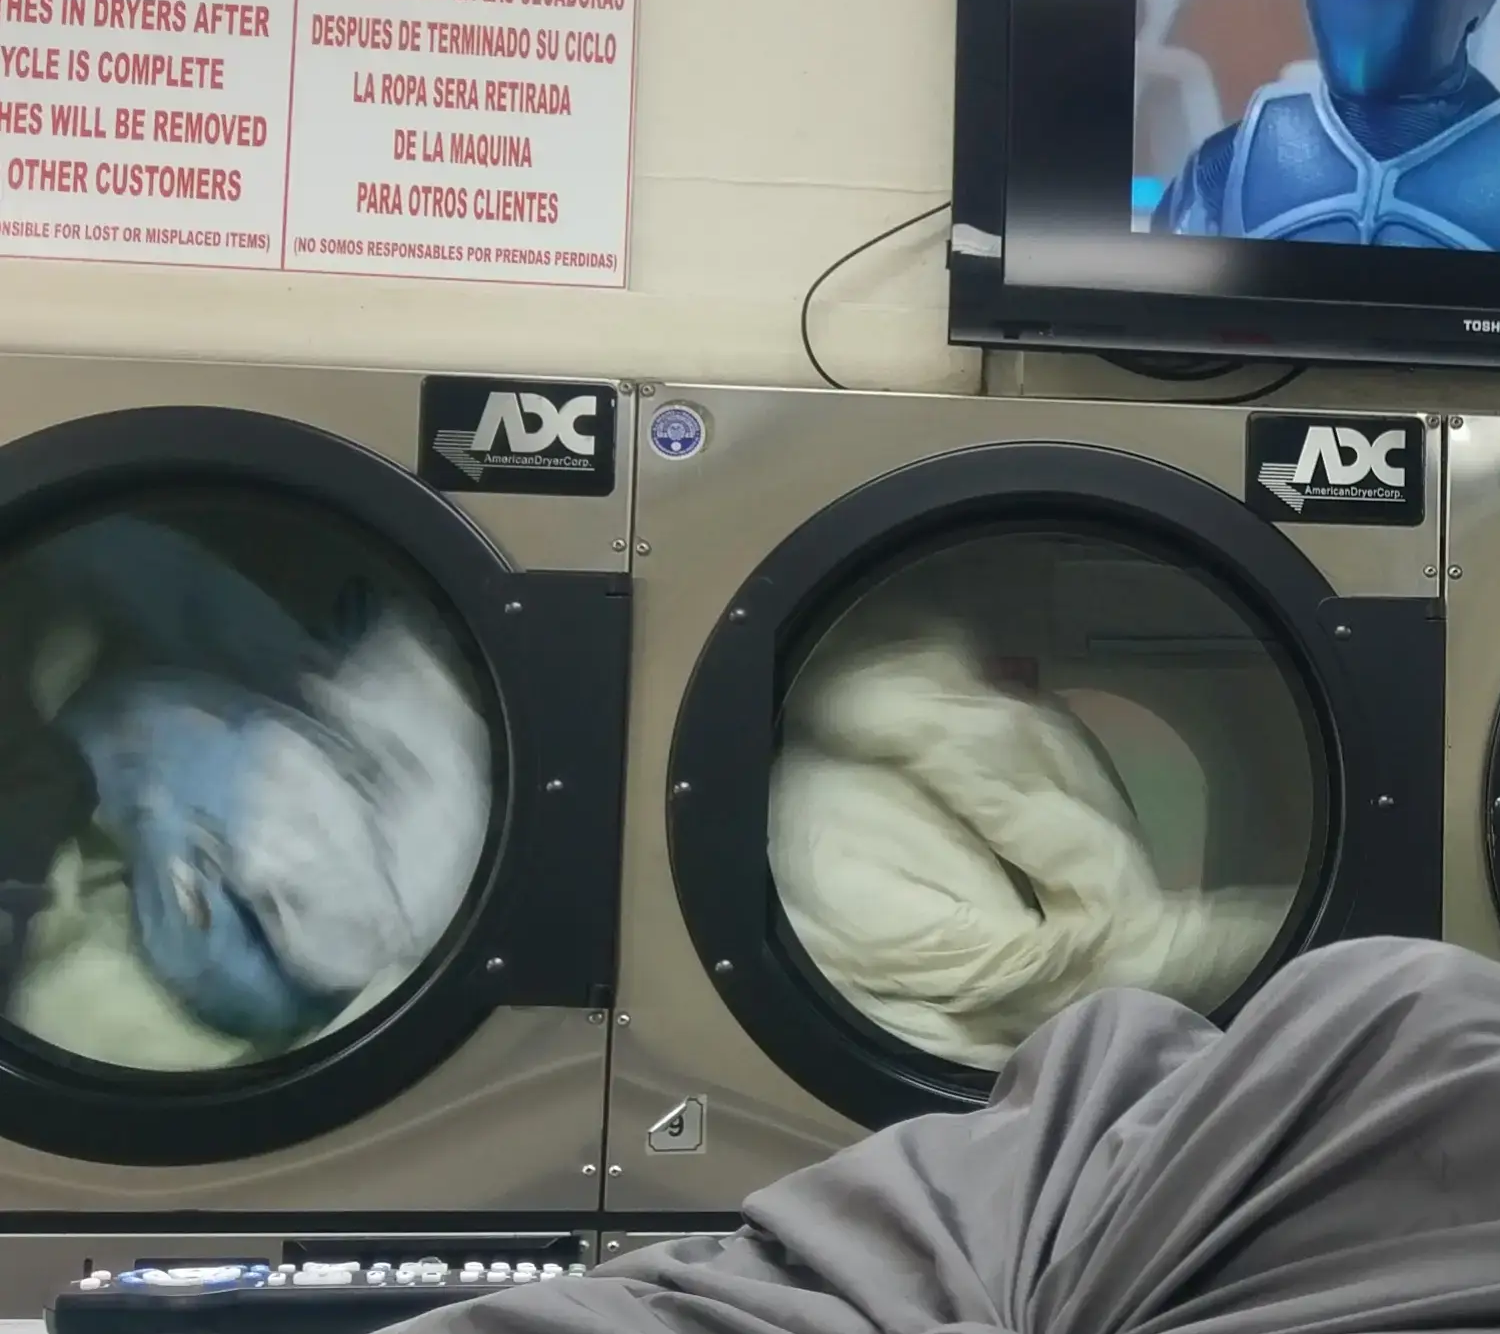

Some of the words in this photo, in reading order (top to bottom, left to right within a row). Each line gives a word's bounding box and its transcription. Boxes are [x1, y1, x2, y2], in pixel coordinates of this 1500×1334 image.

[193, 2, 270, 38] AFTER
[311, 14, 392, 49] DESPUES
[398, 19, 421, 51] DE
[427, 22, 531, 58] TERMINADO
[536, 28, 560, 60] SU
[565, 30, 617, 64] CICLO
[1, 46, 60, 80] YCLE
[67, 50, 91, 82] IS
[98, 52, 225, 90] COMPLETE
[353, 71, 375, 103] LA
[381, 73, 427, 107] ROPA
[433, 77, 479, 110] SERA
[485, 80, 572, 115] RETIRADA
[51, 104, 107, 139] WILL
[114, 108, 146, 141] BE
[153, 110, 267, 147] REMOVED
[393, 129, 417, 161] DE
[422, 132, 444, 163] LA
[450, 133, 533, 168] MAQUINA
[8, 158, 88, 193] OTHER
[96, 163, 242, 201] CUSTOMERS
[356, 182, 403, 216] PARA
[408, 185, 467, 219] OTROS
[473, 188, 559, 224] CLIENTES
[0, 221, 50, 238] NSIBLE
[54, 224, 81, 240] FOR
[85, 225, 119, 242] LOST
[123, 227, 141, 244] OR
[145, 228, 221, 249] MISPLACED
[225, 233, 271, 253] ITEMS)
[293, 237, 316, 257] (NO
[319, 238, 364, 257] SOMOS
[367, 241, 463, 262] RESPONSABLES
[467, 247, 492, 263] POR
[495, 248, 551, 267] PRENDAS
[554, 250, 618, 273] PERDIDAS)
[470, 391, 597, 455] ADC
[1292, 426, 1406, 487] ADC
[668, 1114, 684, 1137] 9
